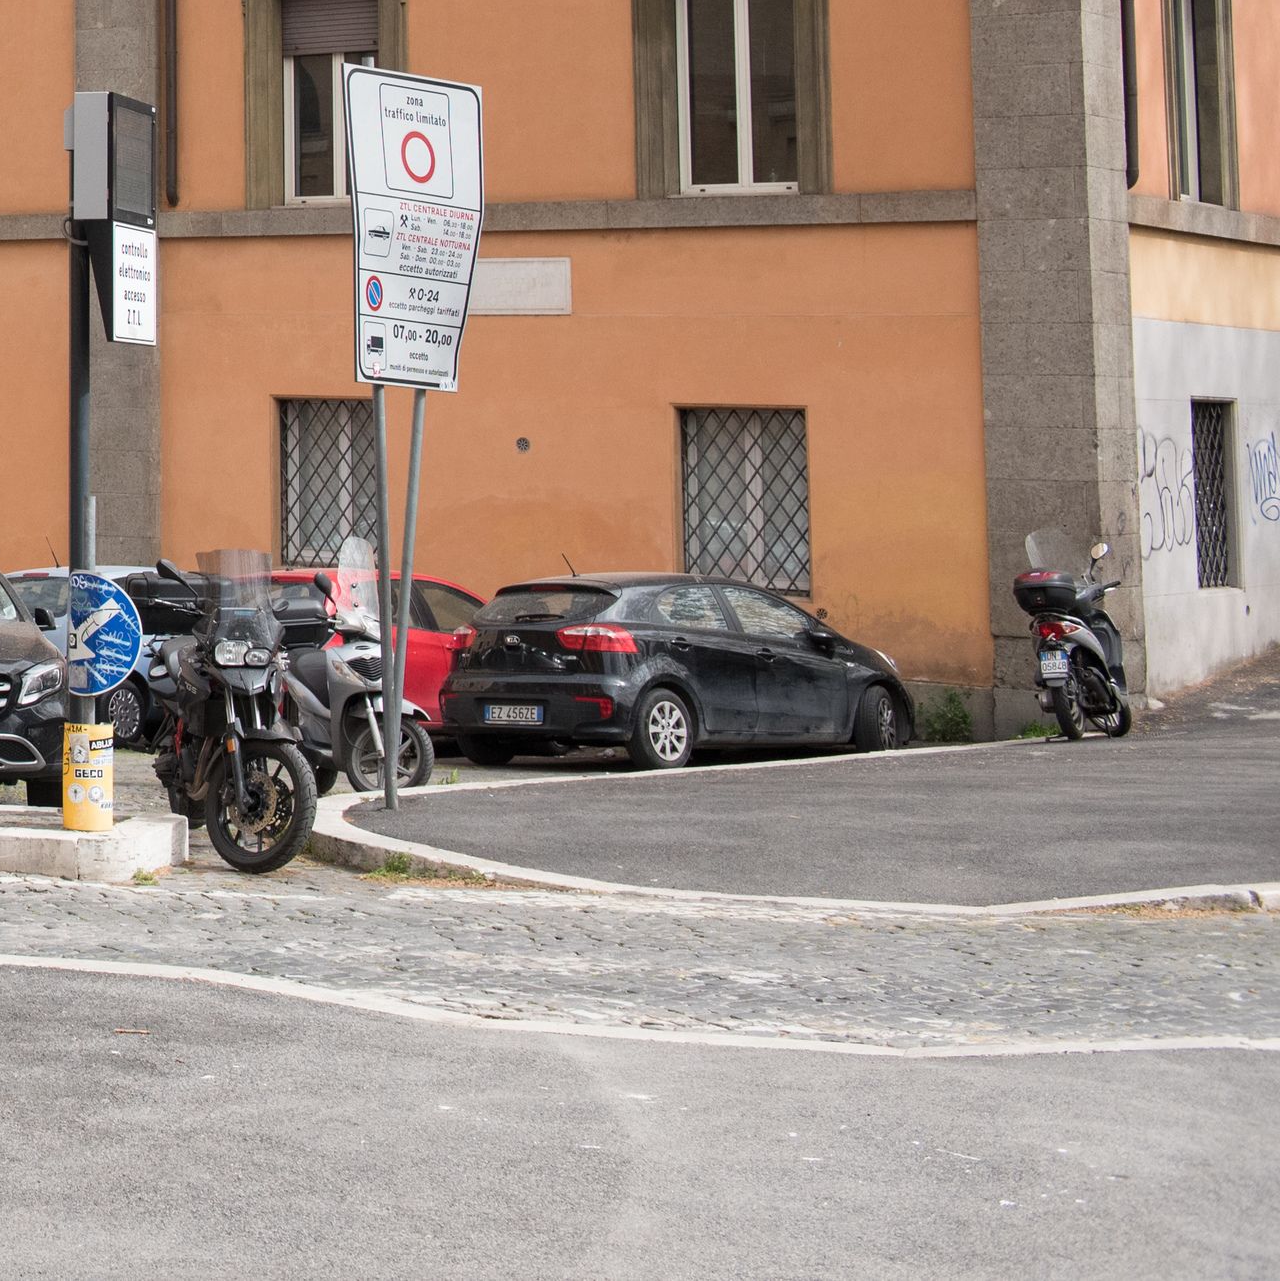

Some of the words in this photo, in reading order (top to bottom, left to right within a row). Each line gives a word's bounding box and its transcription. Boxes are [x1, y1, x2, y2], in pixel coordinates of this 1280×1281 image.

[406, 96, 424, 107] zona
[384, 106, 414, 122] traffico
[416, 111, 446, 127] limitato
[399, 201, 411, 211] ZTL
[413, 204, 448, 217] CENTRALE
[449, 210, 474, 221] DIURNA
[121, 241, 148, 259] controllo
[396, 232, 406, 241] ZTL
[408, 234, 438, 246] CENTRALE
[440, 239, 471, 251] NOTTURNA
[119, 262, 151, 282] elettronico
[399, 264, 423, 274] eccetto
[425, 268, 458, 279] autorizzati
[123, 289, 146, 303] accesso
[389, 301, 407, 311] eccetto
[408, 303, 435, 316] parcheggi
[437, 306, 460, 318] tariffati
[393, 324, 417, 343] 07,00
[425, 328, 452, 348] 20,00
[409, 351, 429, 362] eccetto
[74, 768, 103, 778] GECO
